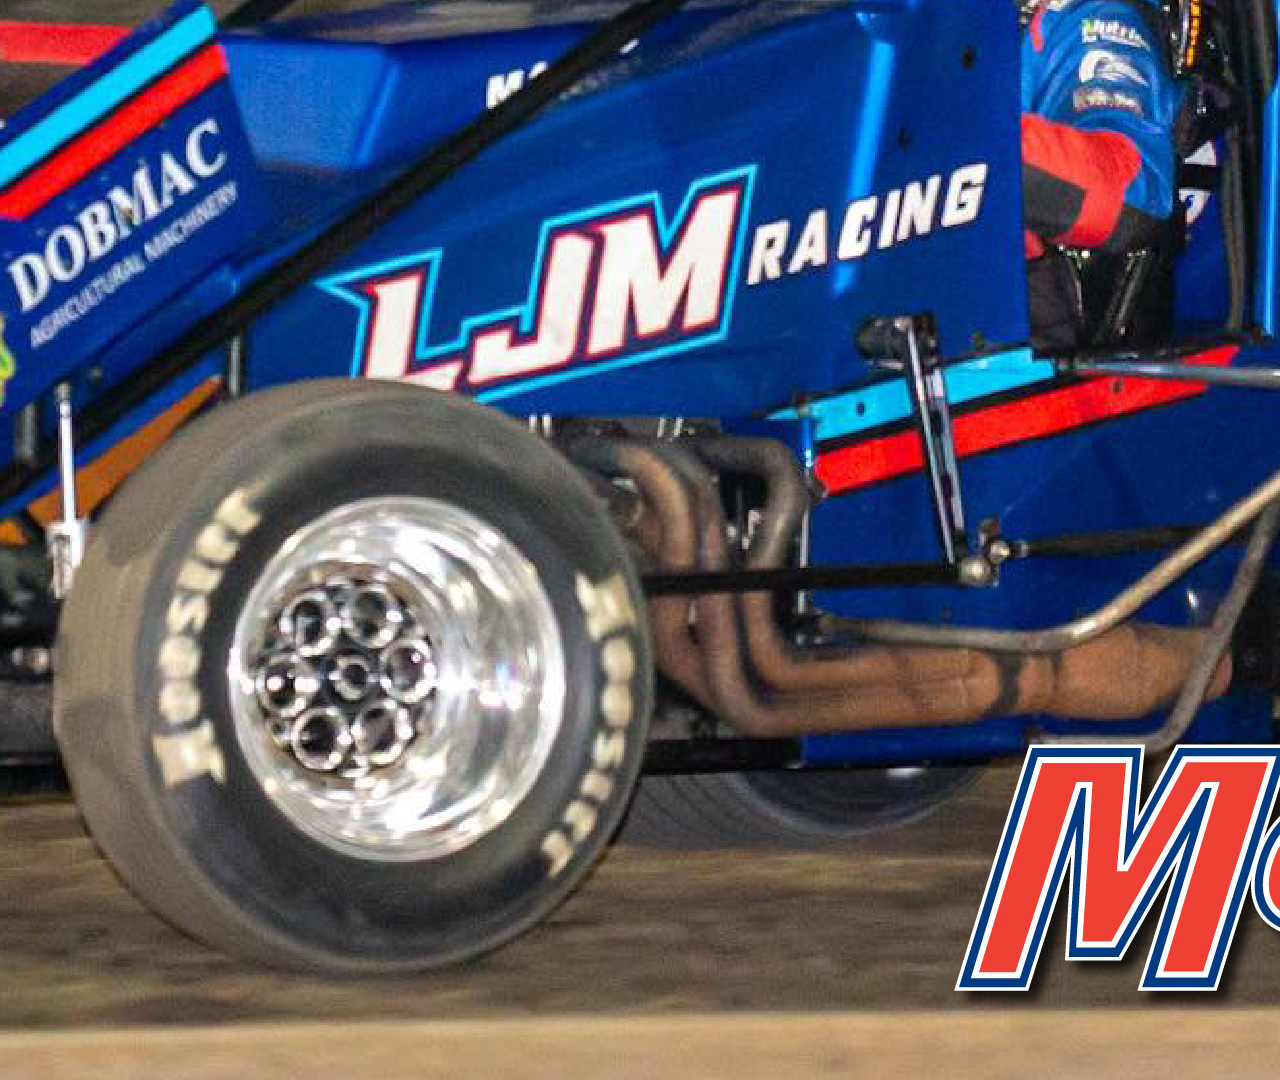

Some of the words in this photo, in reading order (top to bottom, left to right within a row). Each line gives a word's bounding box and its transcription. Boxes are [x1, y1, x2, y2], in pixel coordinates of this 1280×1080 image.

[8, 118, 227, 312] DOBMAC
[360, 176, 747, 392] LJM
[747, 163, 988, 285] RACING
